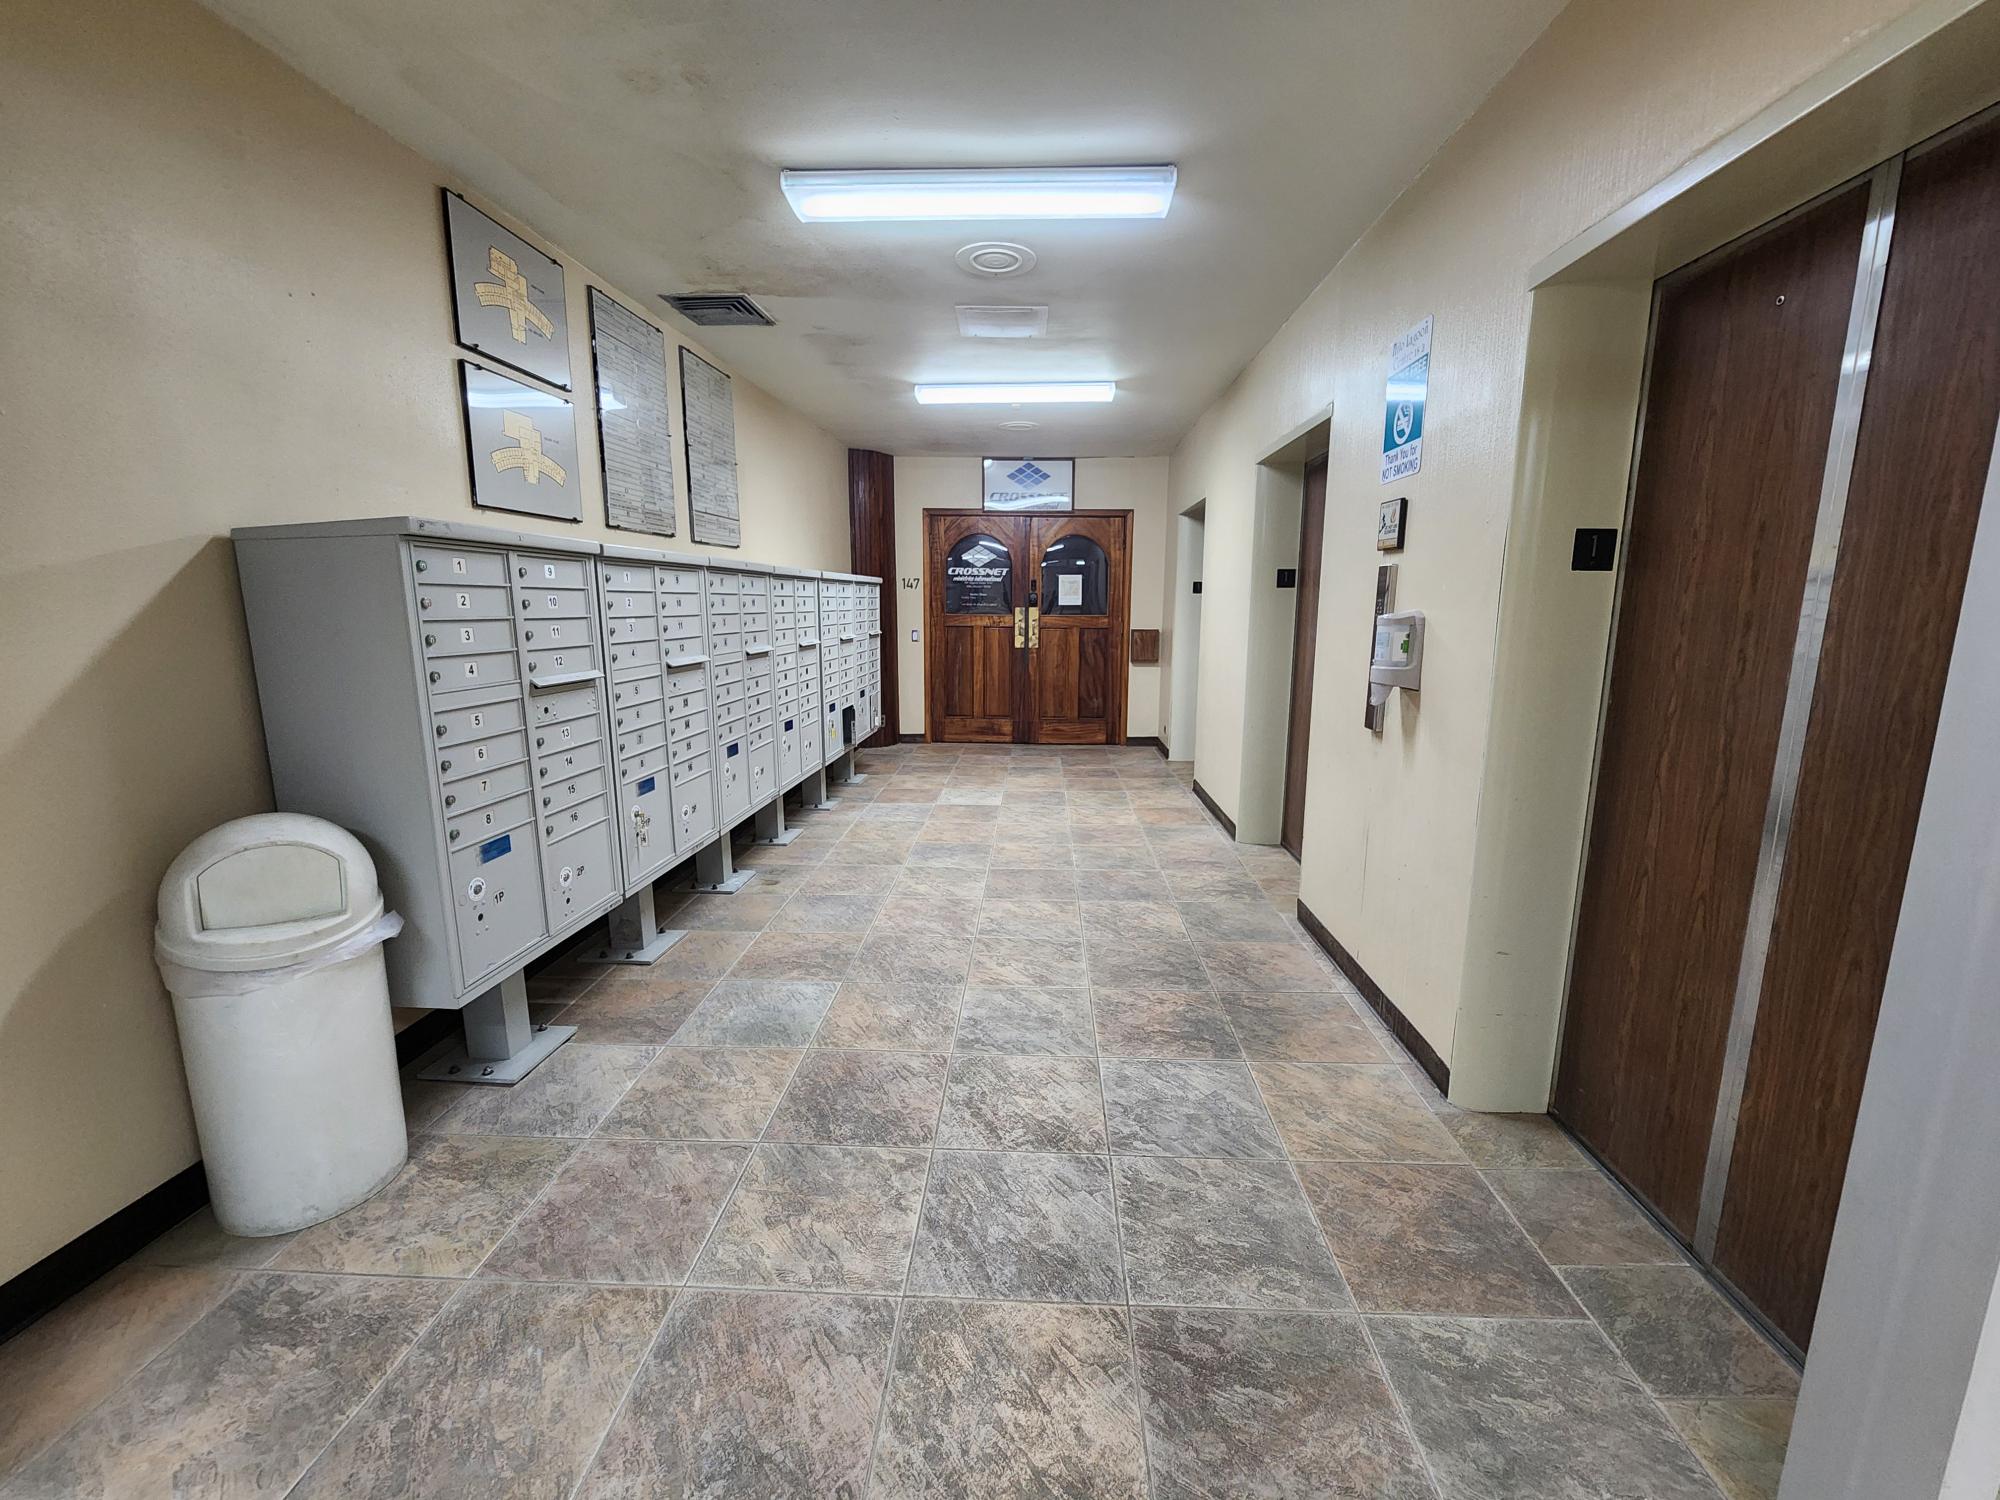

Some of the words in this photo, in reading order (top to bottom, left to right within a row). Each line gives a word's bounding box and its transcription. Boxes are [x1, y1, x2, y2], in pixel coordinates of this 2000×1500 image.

[1385, 451, 1398, 467] Thank
[1400, 447, 1409, 460] You
[1410, 443, 1418, 456] for
[1382, 467, 1392, 482] NOT
[1393, 457, 1418, 477] SMOKING
[1591, 535, 1599, 557] 1
[456, 561, 462, 571] 1
[547, 567, 552, 576] 9
[948, 567, 1010, 576] CROSSNET
[902, 577, 920, 590] 147
[460, 595, 466, 606] 2
[549, 597, 557, 607] 10
[464, 630, 470, 641] 3
[552, 627, 560, 637] 11
[555, 656, 563, 666] 12
[468, 664, 475, 675] 4
[474, 715, 480, 726] 5
[562, 729, 570, 738] 13
[478, 748, 484, 758] 6
[565, 757, 573, 766] 14
[481, 781, 487, 791] 7
[568, 785, 576, 794] 15
[486, 814, 491, 824] 8
[570, 812, 578, 822] 16
[577, 866, 585, 876] 2P
[494, 891, 504, 905] 1P
